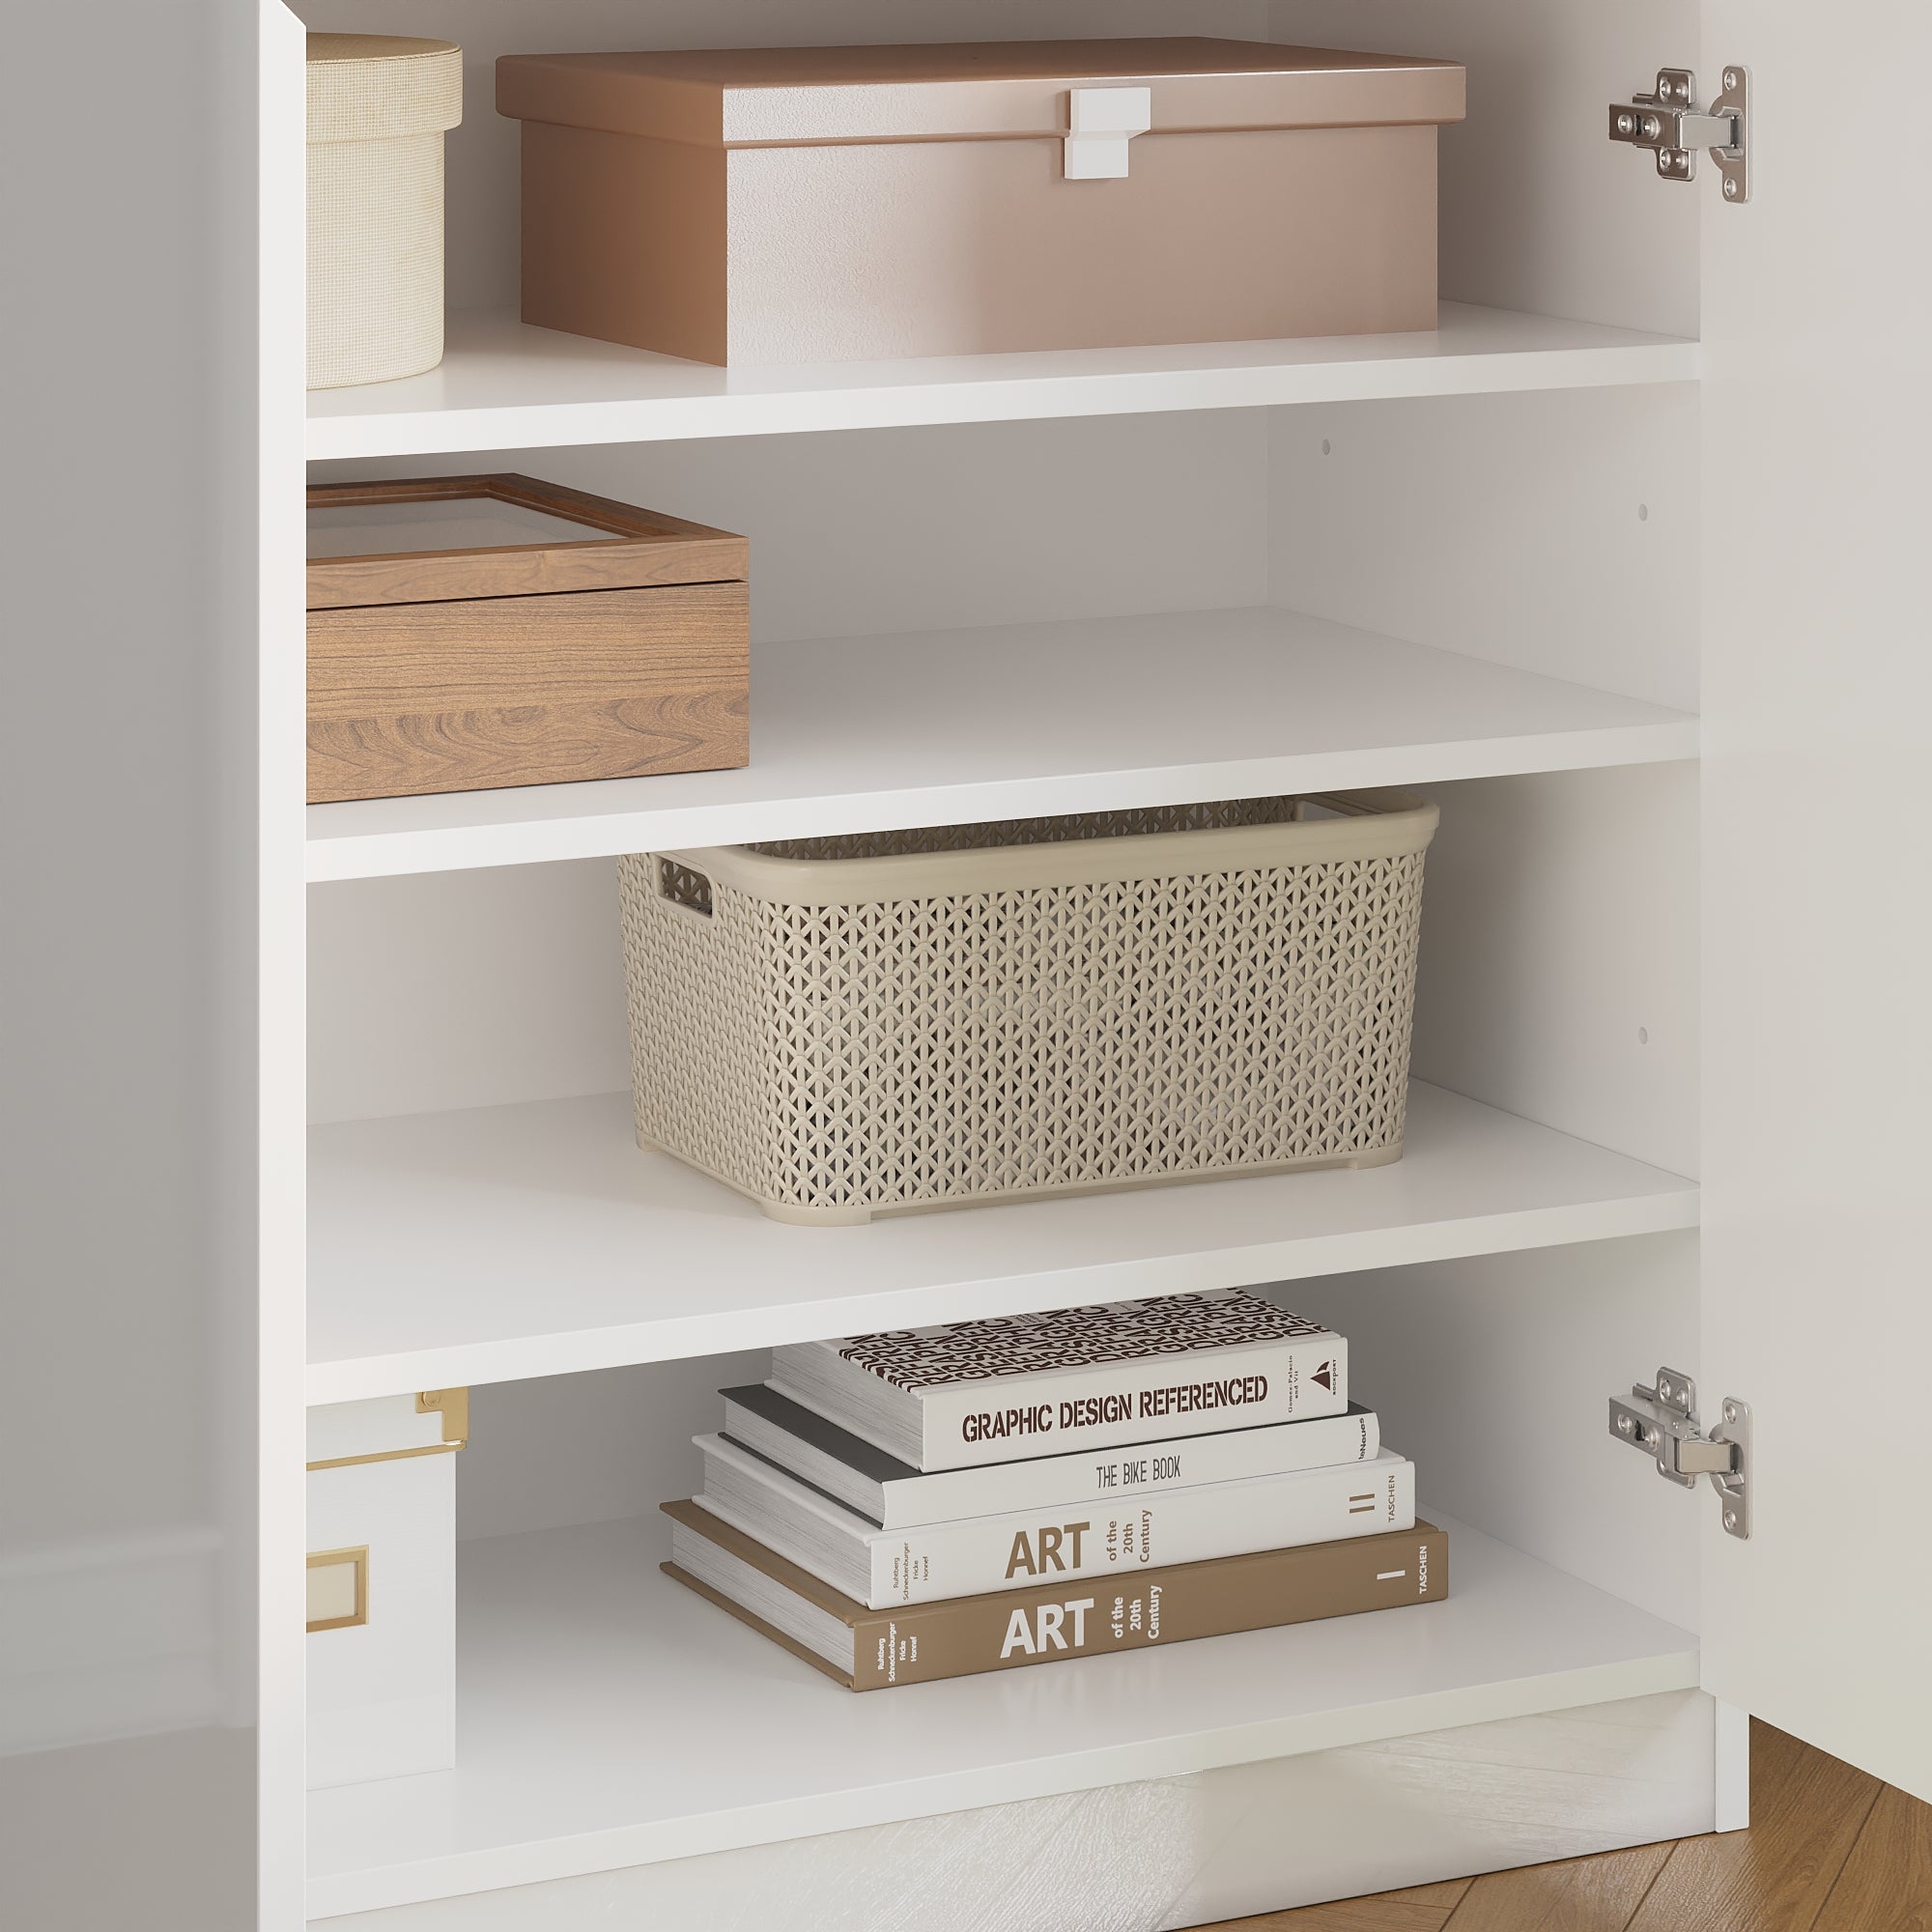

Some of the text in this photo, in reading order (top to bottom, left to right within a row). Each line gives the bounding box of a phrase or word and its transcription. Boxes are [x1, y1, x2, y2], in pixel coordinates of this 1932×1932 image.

[1037, 1309, 1159, 1358] REFEREN
[1065, 1306, 1188, 1352] GRAPHIC
[1132, 1297, 1256, 1346] REFEREN
[1158, 1293, 1284, 1340] GRAPHIC
[843, 1334, 961, 1385] REFEREN
[872, 1331, 992, 1380] GRAPHIC
[941, 1321, 1061, 1372] REFEREN
[970, 1319, 1091, 1366] GRAPHIC
[962, 1375, 1268, 1443] GRAPHIC DESIGN REFERENCED
[1095, 1455, 1181, 1489] THE BIKE BOOK
[1005, 1520, 1091, 1579] ART
[1106, 1520, 1117, 1561] of the
[1122, 1522, 1133, 1554] 20th
[1139, 1509, 1152, 1563] Century
[1419, 1546, 1428, 1594] TASCHEN
[1000, 1597, 1094, 1660] ART
[1111, 1596, 1123, 1639] of the
[1129, 1598, 1142, 1631] 20th
[1148, 1584, 1163, 1639] Century
